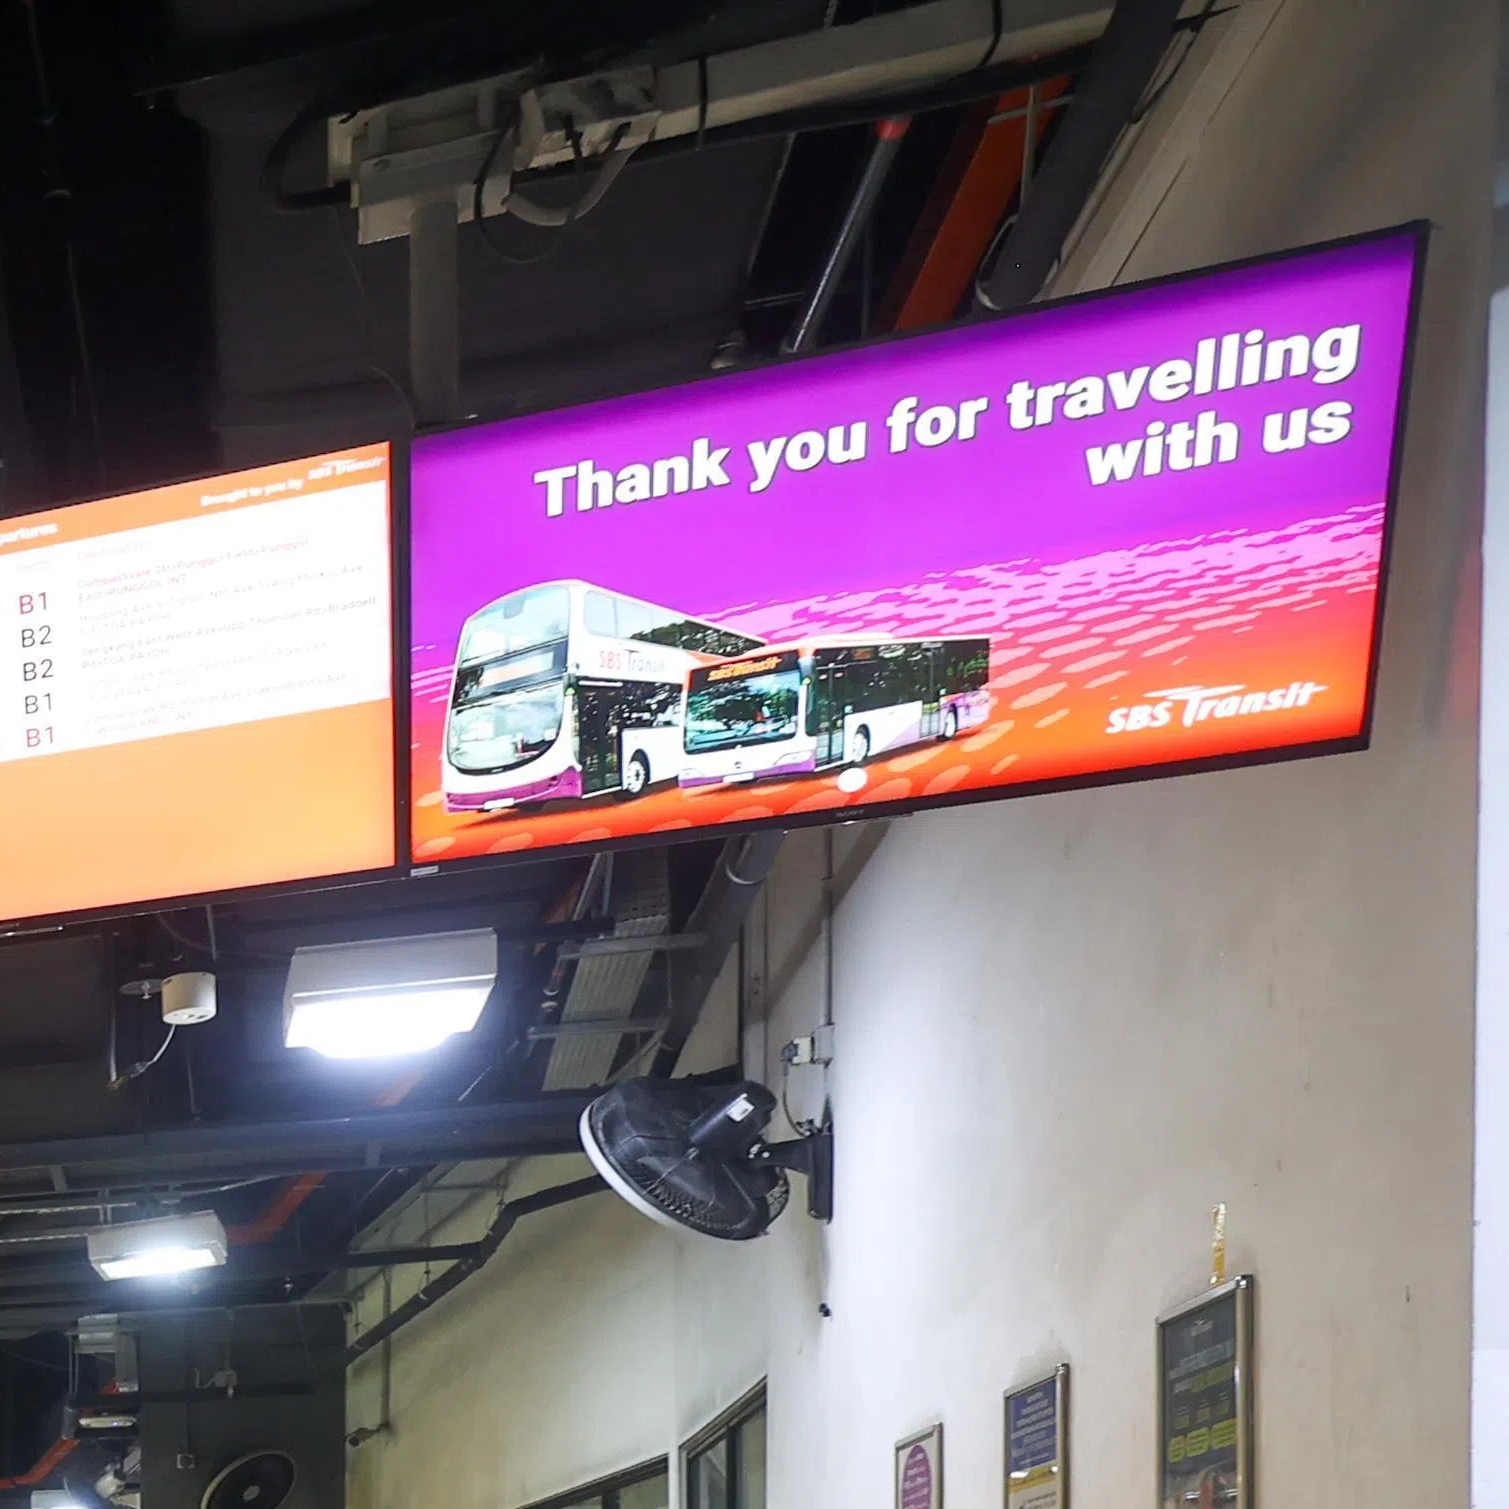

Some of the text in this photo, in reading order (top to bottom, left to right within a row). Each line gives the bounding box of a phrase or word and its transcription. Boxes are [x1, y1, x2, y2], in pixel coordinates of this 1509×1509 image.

[533, 320, 1364, 519] Thank you for travelling
[1084, 395, 1354, 488] with us
[18, 591, 48, 616] B1
[20, 624, 53, 649] B2
[22, 658, 54, 683] B2
[24, 692, 52, 716] B1
[1105, 681, 1329, 734] SBS Transit
[25, 725, 55, 749] B1
